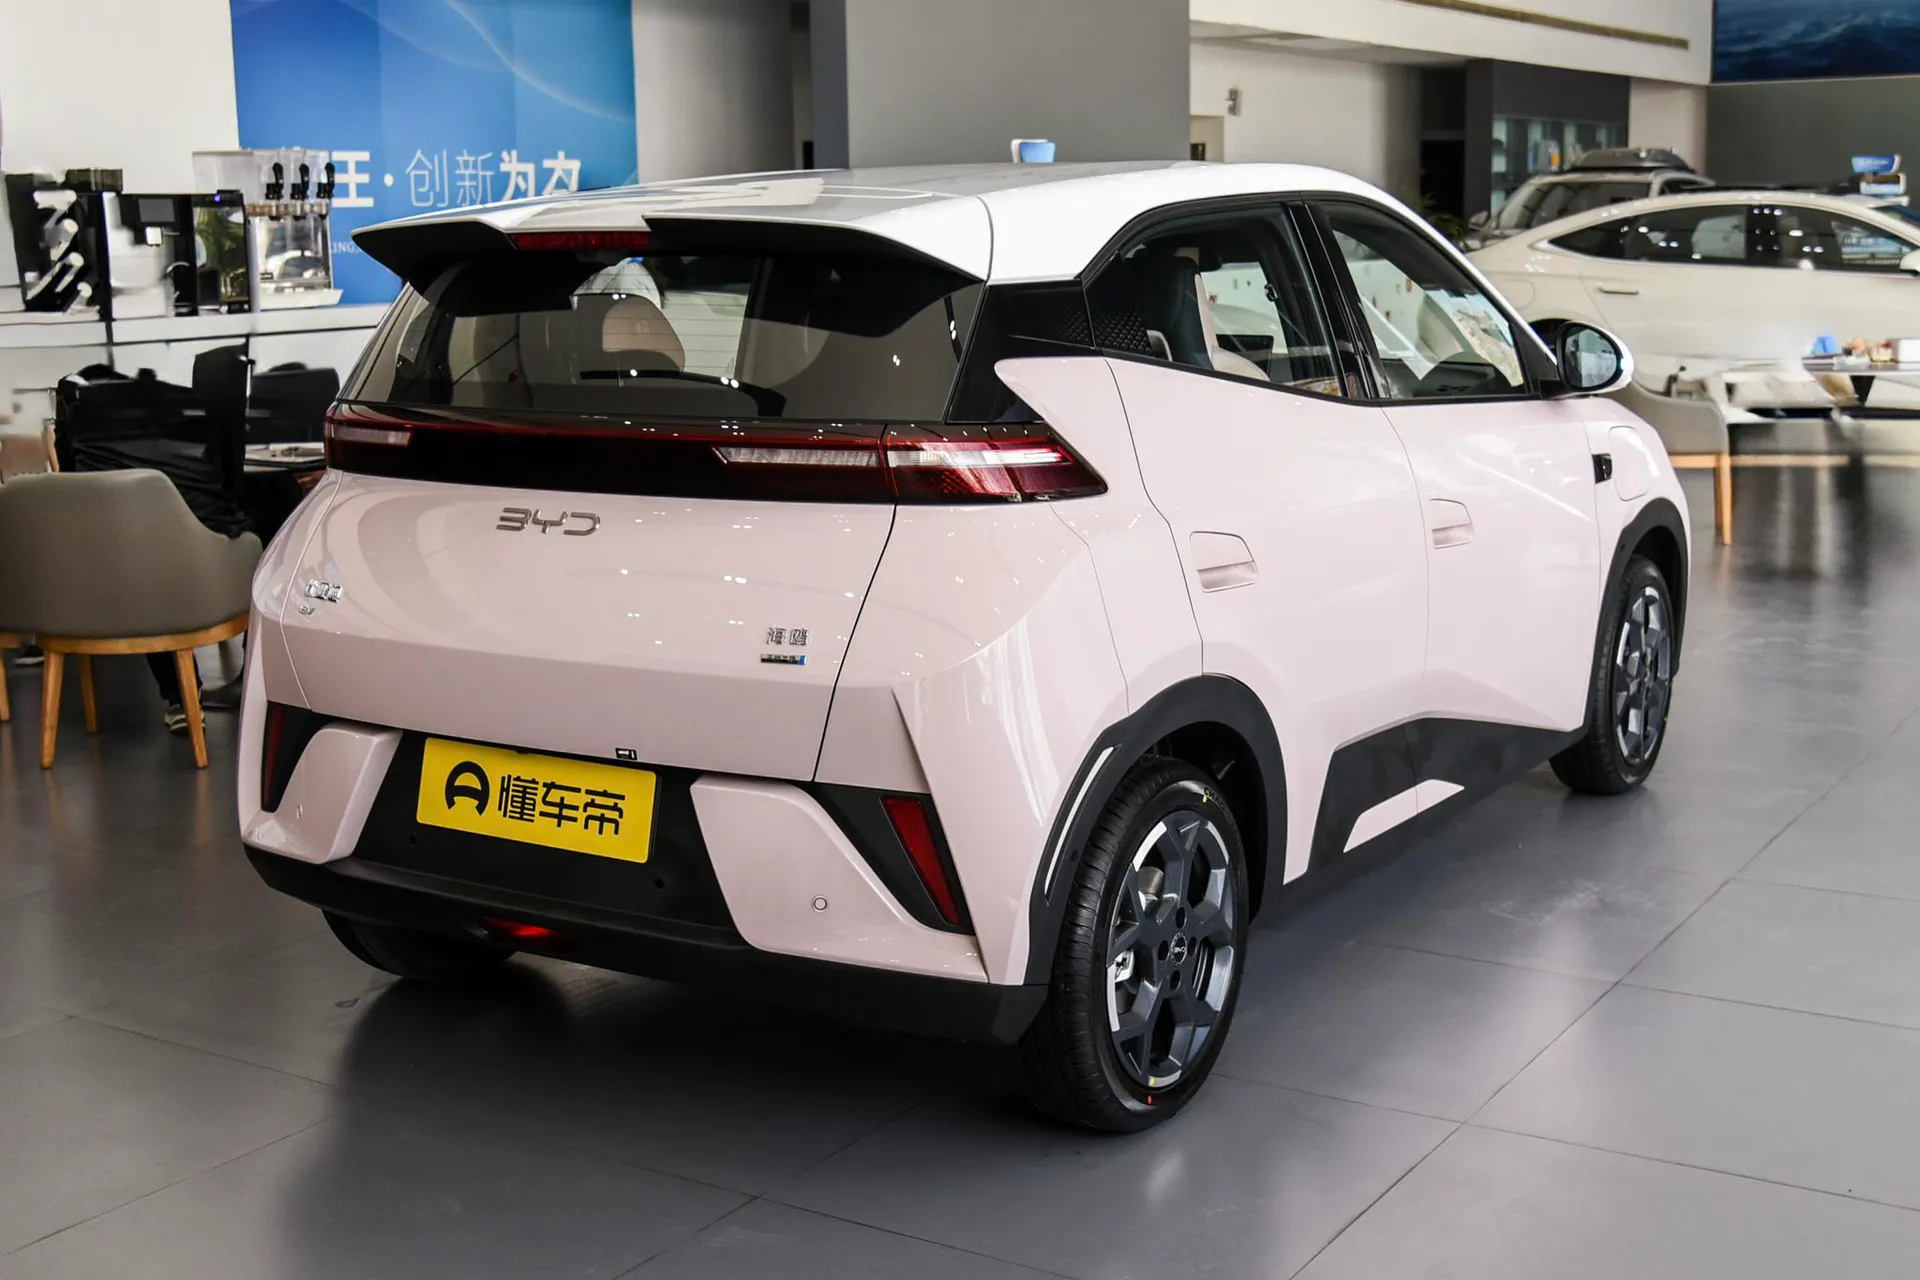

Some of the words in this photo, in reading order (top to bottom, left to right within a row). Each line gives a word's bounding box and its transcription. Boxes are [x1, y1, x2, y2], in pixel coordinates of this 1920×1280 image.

[496, 507, 601, 536] BYD
[497, 774, 626, 836] 懂车帝
